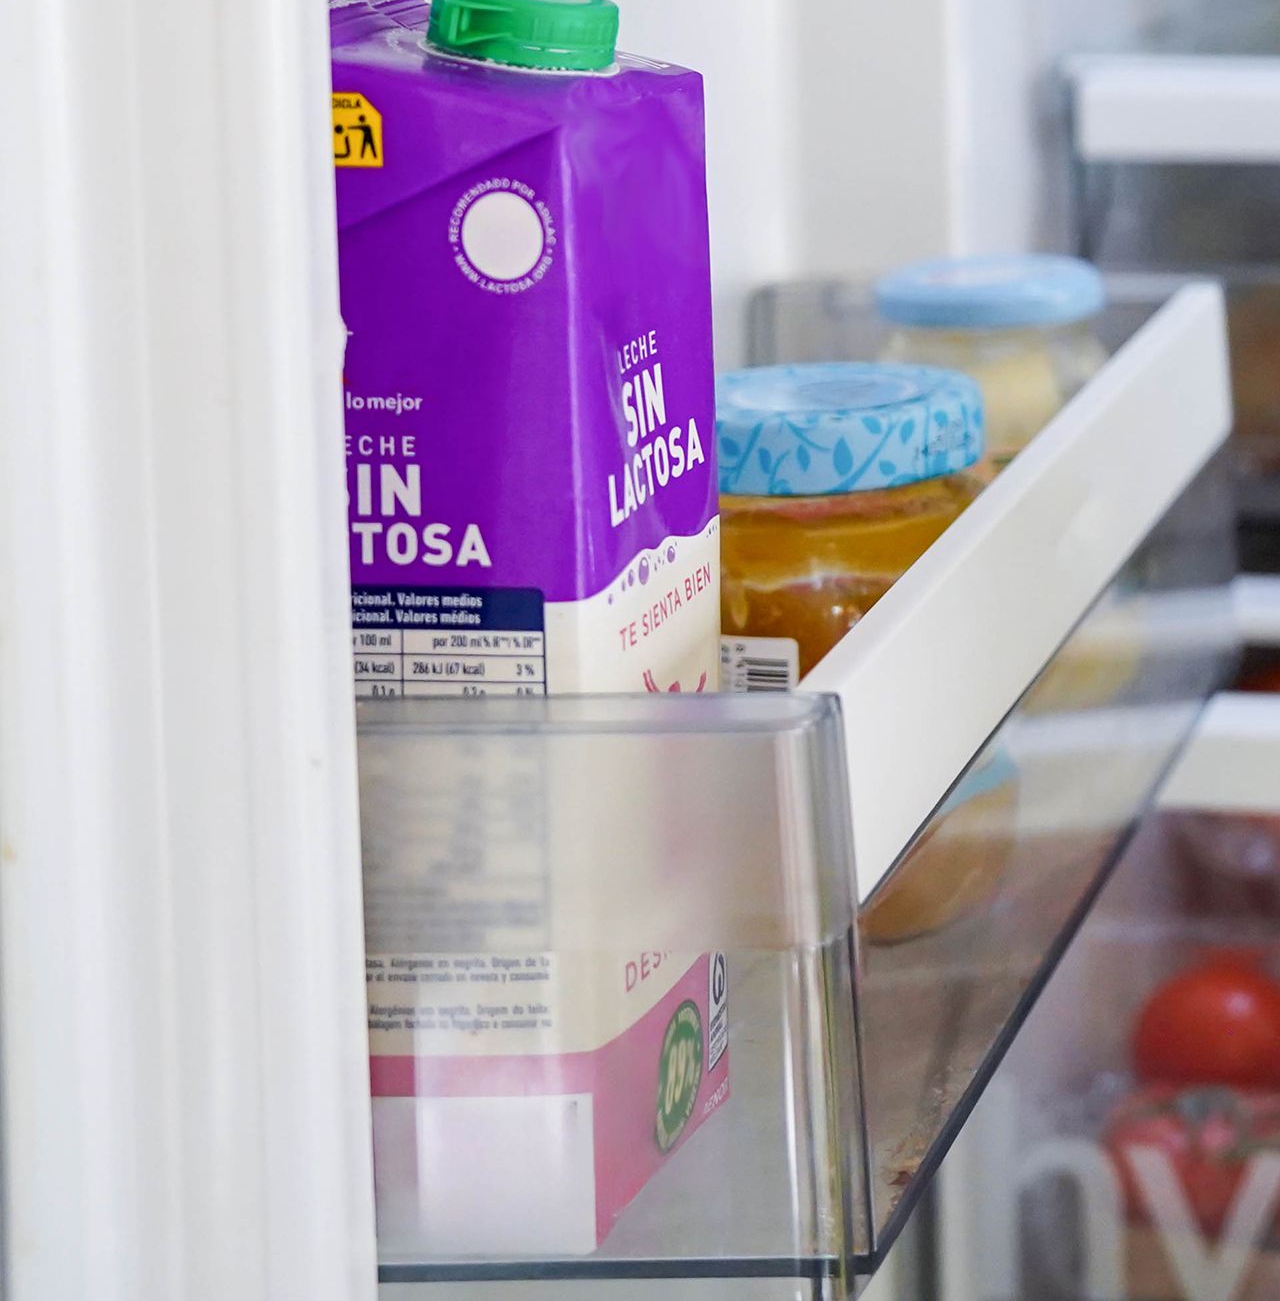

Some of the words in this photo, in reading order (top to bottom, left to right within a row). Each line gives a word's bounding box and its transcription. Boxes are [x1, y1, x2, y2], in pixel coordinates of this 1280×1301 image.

[511, 179, 536, 200] POR
[618, 330, 657, 374] LECHE
[346, 392, 365, 410] lo
[367, 393, 423, 415] mejor
[622, 362, 666, 447] SIN
[345, 435, 416, 456] ECHE
[608, 417, 705, 528] LACTOSA
[356, 463, 422, 517] IN
[351, 522, 492, 567] TOSA
[397, 592, 440, 607] Valores
[620, 622, 637, 651] TE
[642, 587, 682, 637] SIENTA
[684, 562, 711, 601] BIEN
[395, 609, 438, 624] Valores
[360, 634, 377, 646] 100
[433, 637, 448, 650] por
[450, 634, 468, 648] 200
